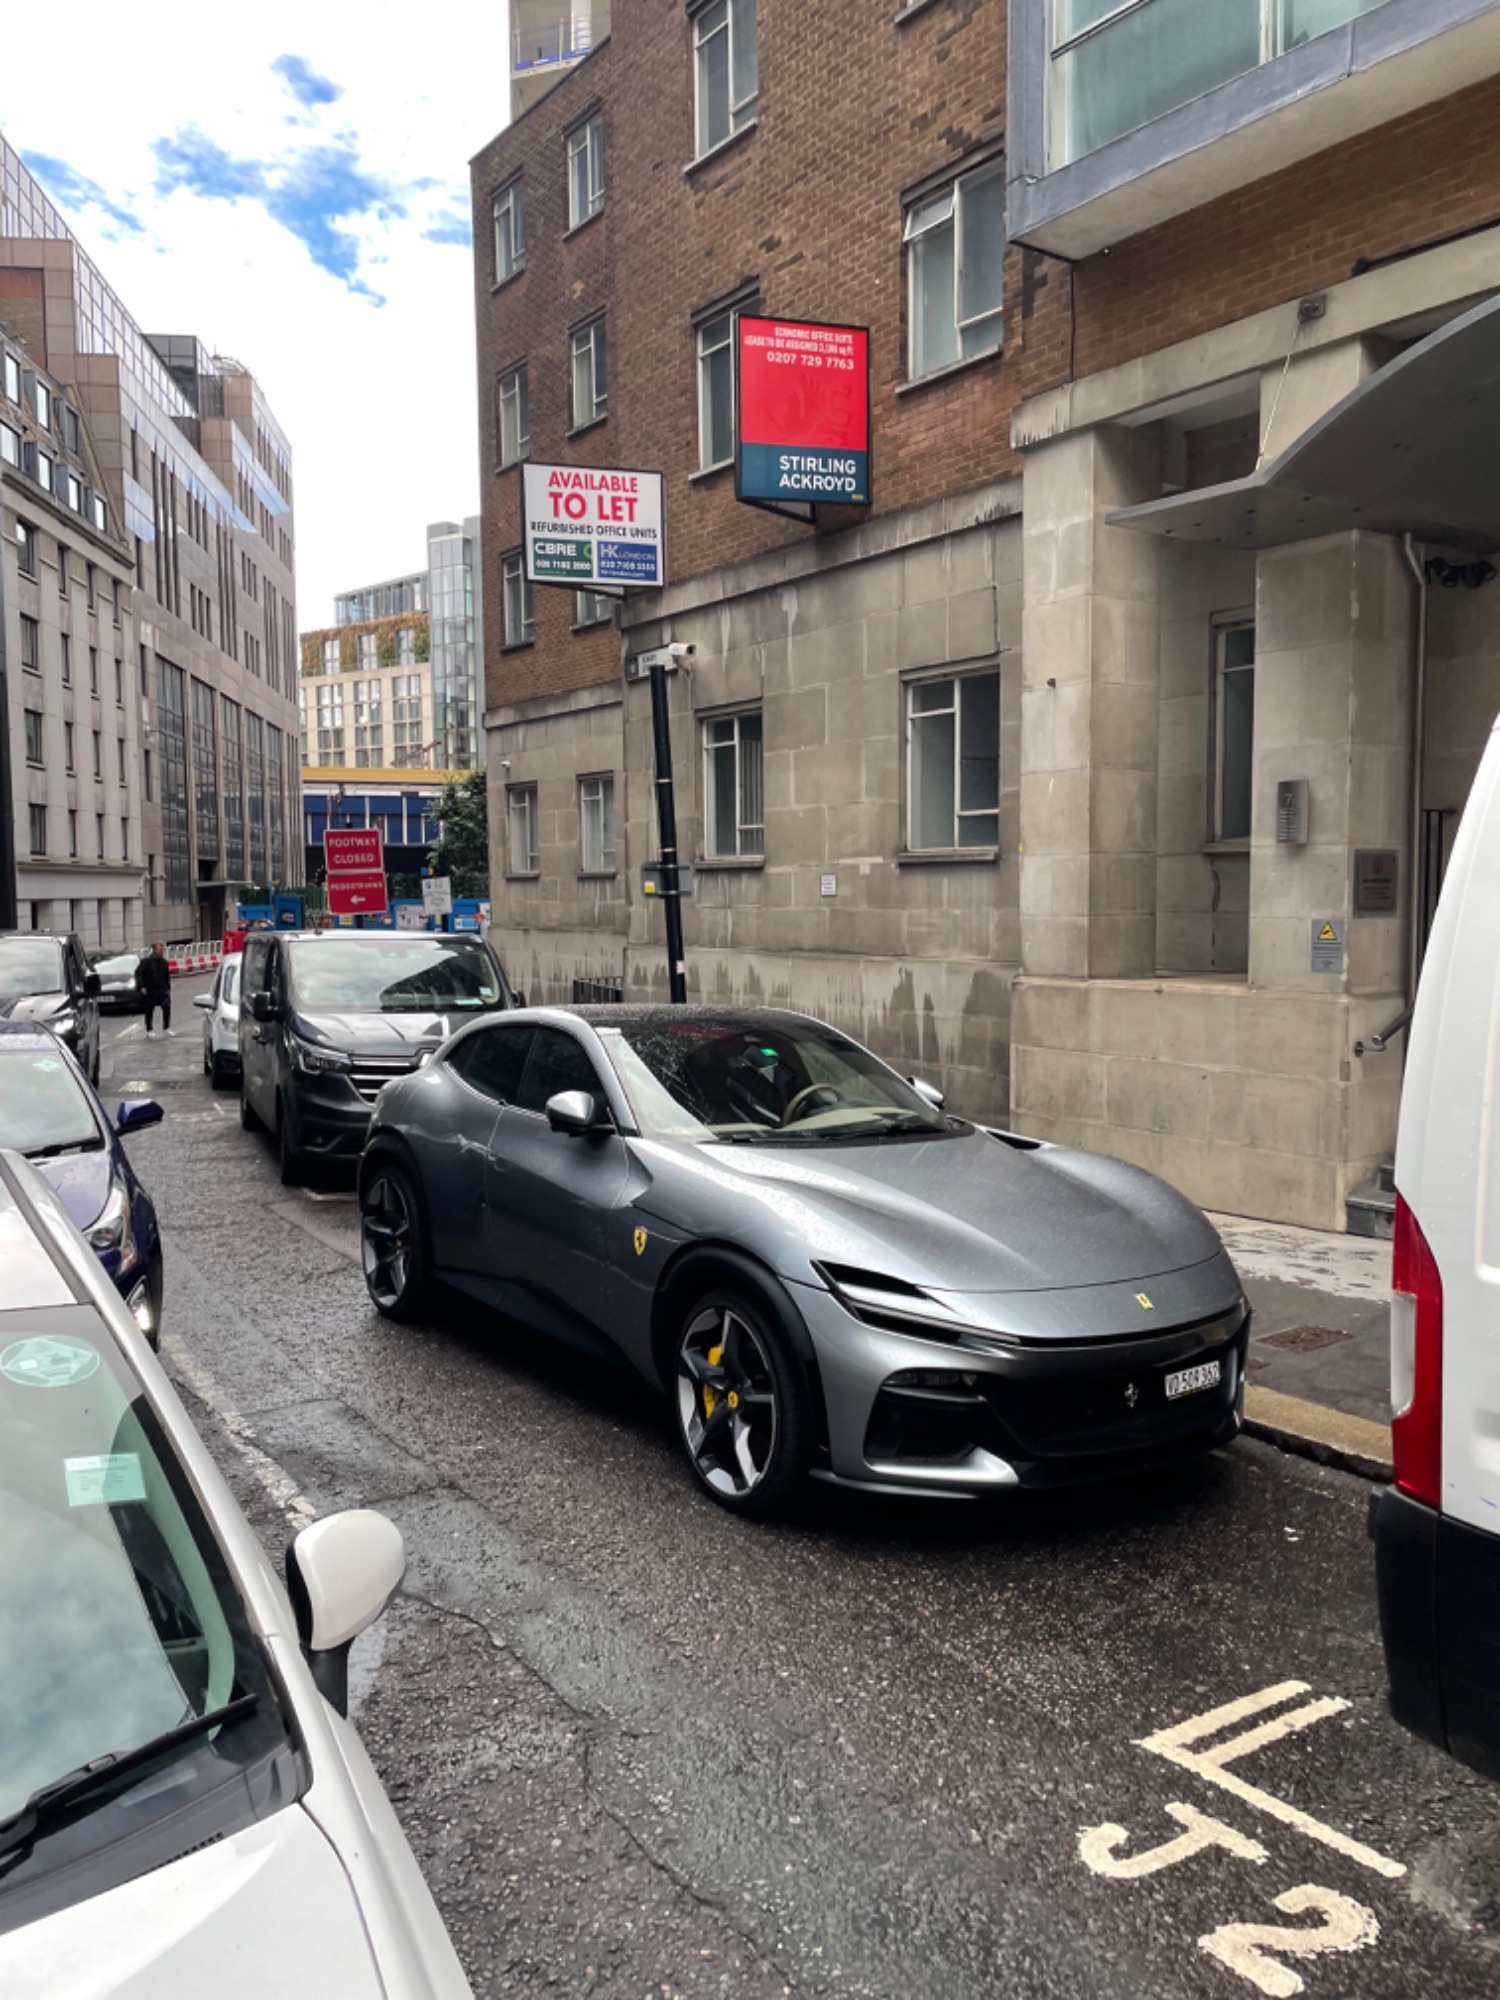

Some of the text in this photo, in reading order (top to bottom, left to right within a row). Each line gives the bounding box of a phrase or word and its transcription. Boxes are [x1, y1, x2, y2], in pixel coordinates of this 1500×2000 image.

[765, 336, 774, 347] TO
[775, 338, 784, 348] BE
[811, 330, 834, 342] OFFICE
[767, 351, 855, 370] 0207 729 7763
[779, 455, 856, 474] STIRLING
[548, 470, 638, 493] AVAILABLE
[779, 473, 856, 491] ACKROYD
[548, 491, 638, 522] TO LET
[530, 521, 657, 539] REFURBISHED OFFICE UNITS
[534, 541, 577, 557] CBRE
[618, 549, 655, 561] LONDON
[329, 837, 377, 848] FOOTWAY
[333, 853, 375, 864] CLOSED
[331, 881, 384, 891] PEDESTRIANS
